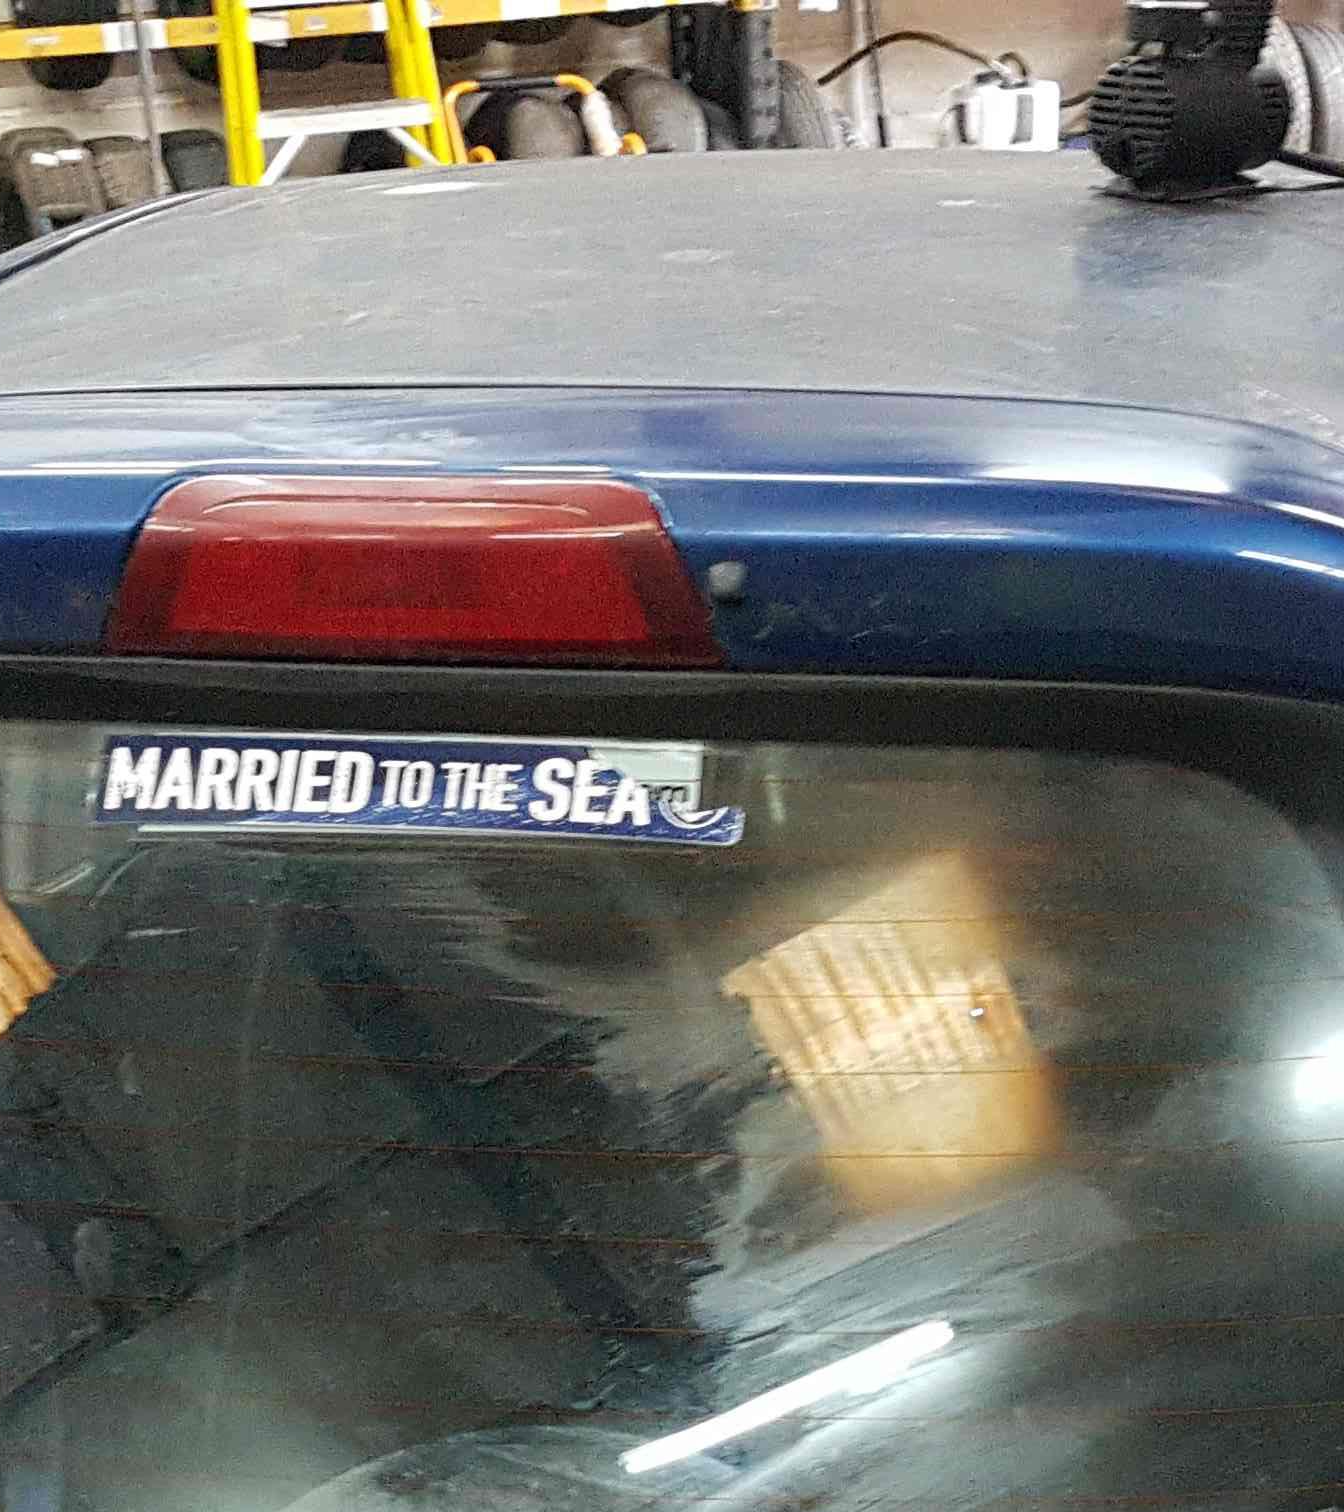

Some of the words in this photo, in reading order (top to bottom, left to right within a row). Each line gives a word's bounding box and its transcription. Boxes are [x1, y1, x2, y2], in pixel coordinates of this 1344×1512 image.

[102, 746, 374, 814] MARRIED
[378, 758, 431, 808] TO
[440, 760, 524, 814] THE
[530, 756, 652, 827] SEA
